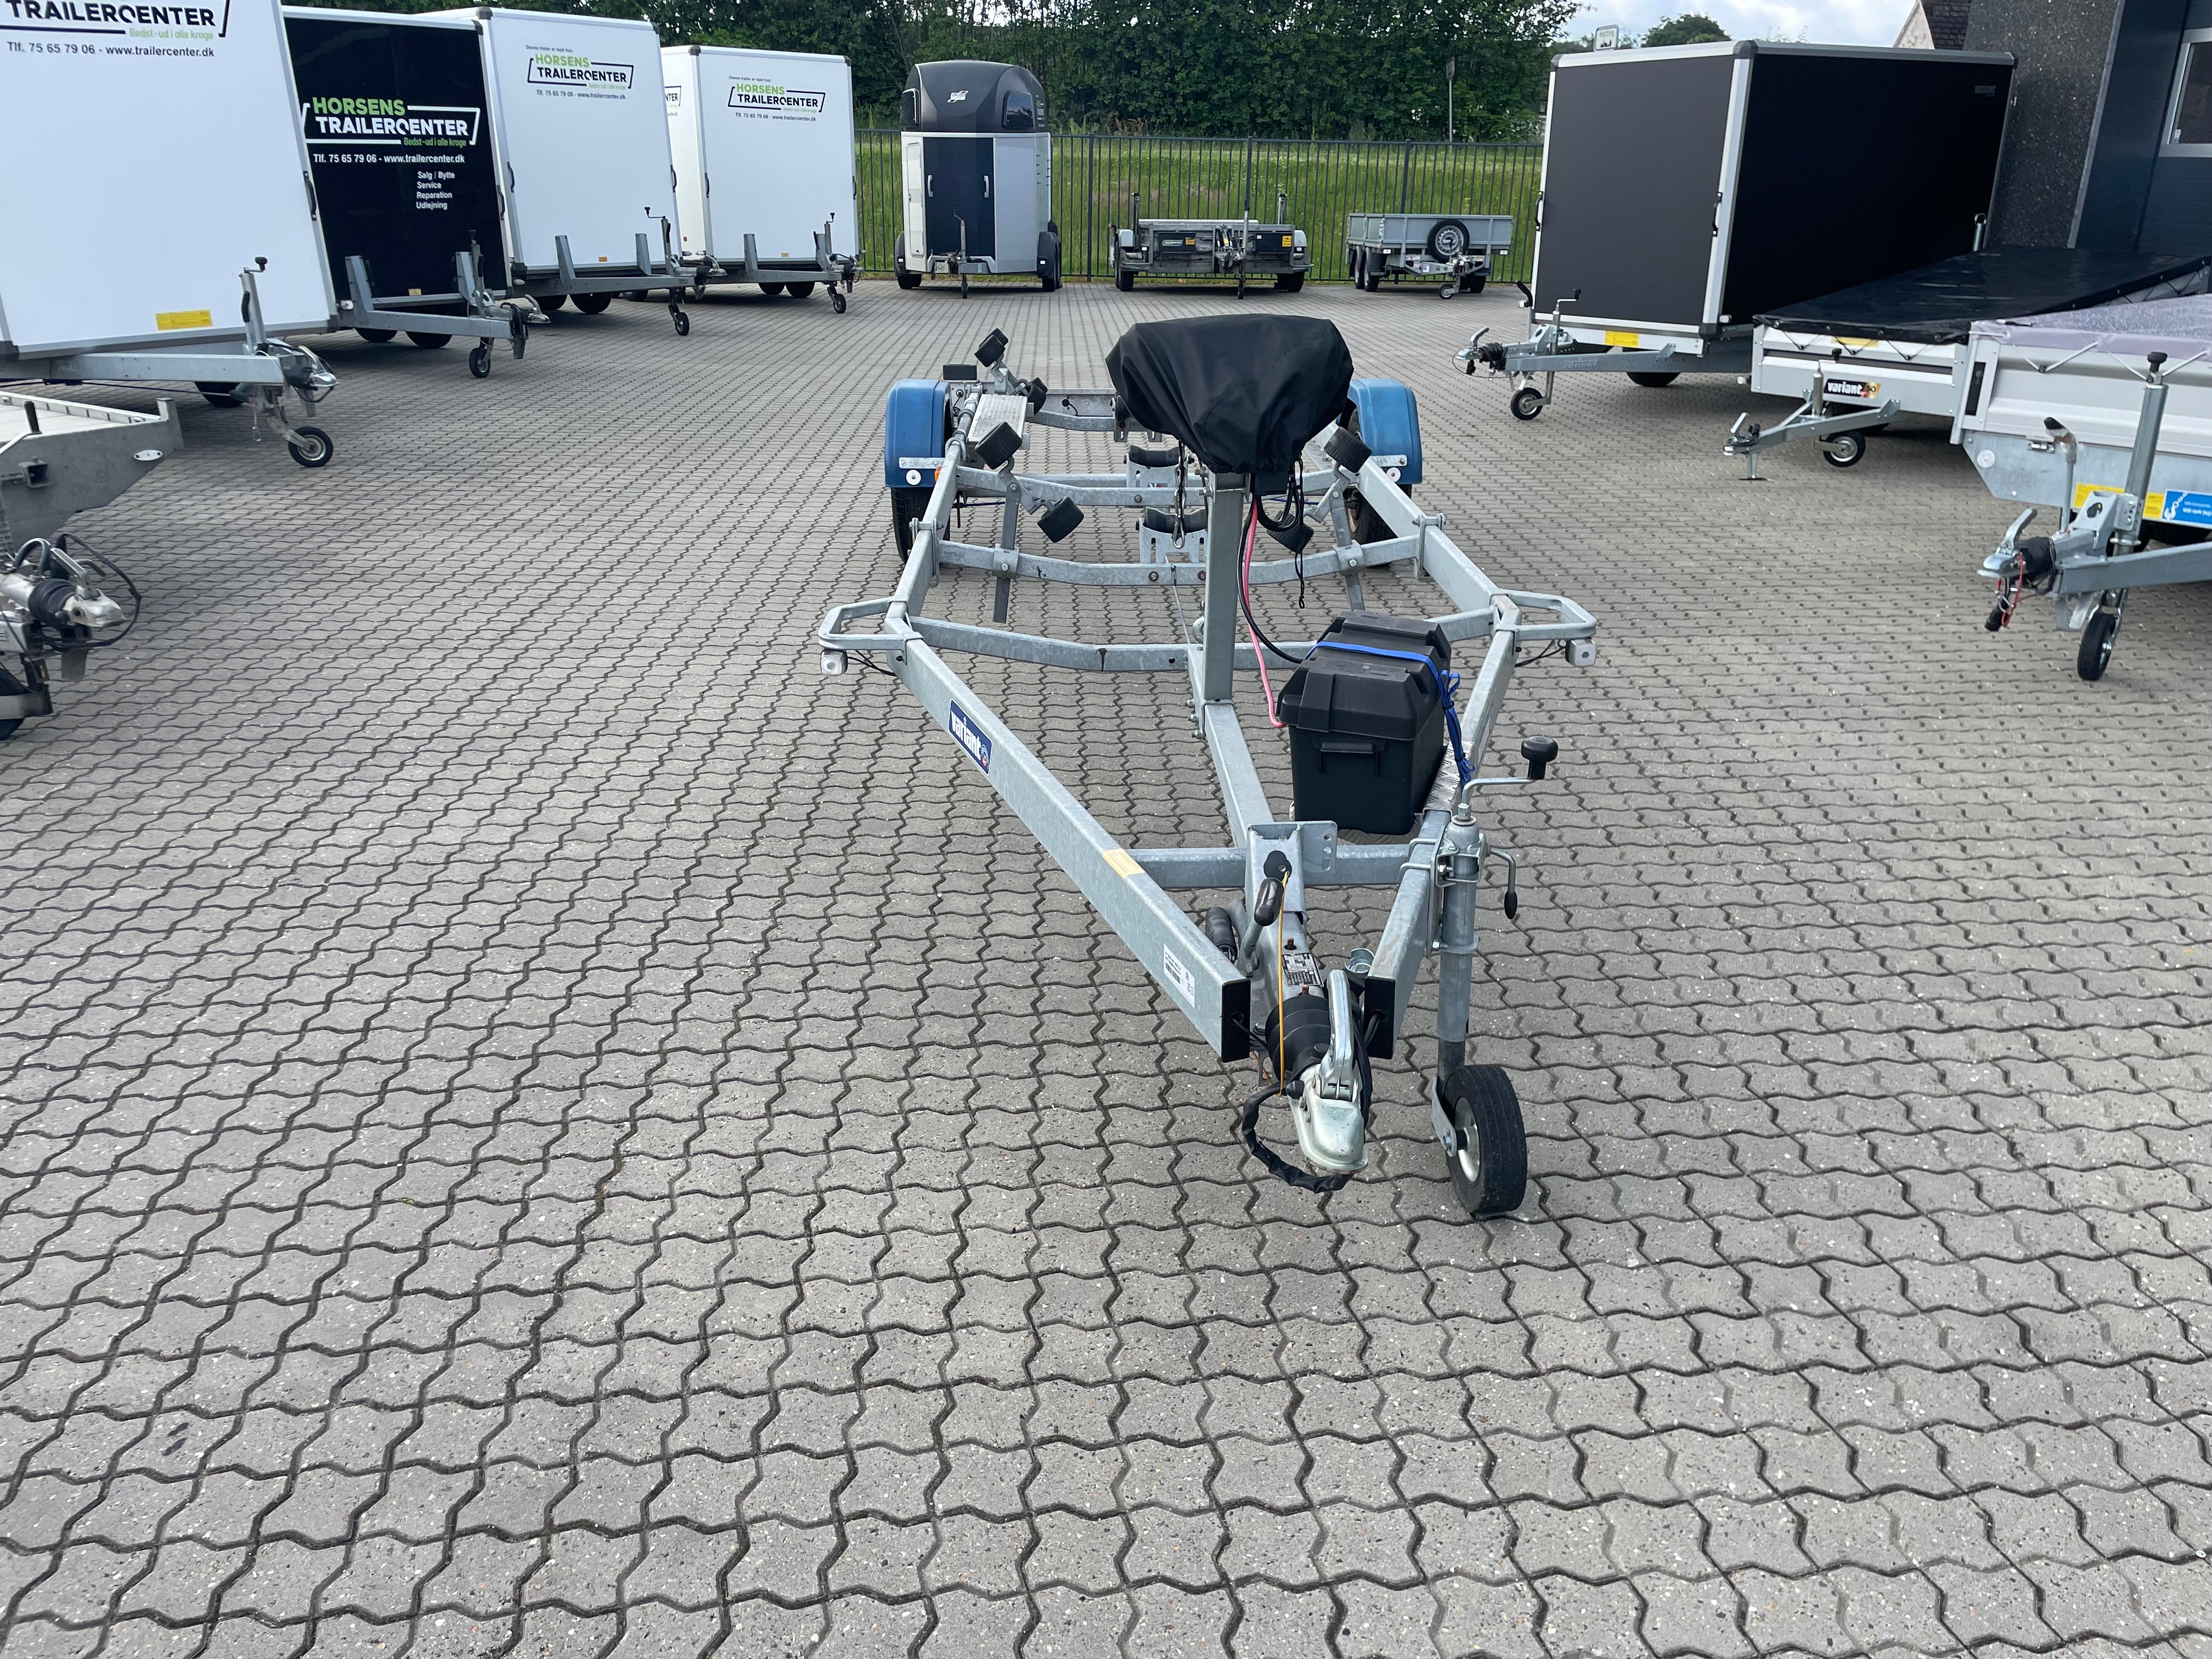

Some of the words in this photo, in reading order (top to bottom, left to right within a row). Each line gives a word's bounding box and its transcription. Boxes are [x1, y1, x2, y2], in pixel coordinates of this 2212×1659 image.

[4, 0, 216, 26] TRAILERCENTER
[175, 30, 189, 39] alle
[190, 31, 213, 41] kroge
[7, 41, 25, 52] Tlf.
[29, 42, 43, 53] 75
[47, 43, 60, 53] 65
[64, 44, 77, 54] 79
[82, 44, 95, 54] 06
[105, 46, 215, 57] www.trailercenter.dk
[535, 53, 590, 67] HORSENS
[537, 66, 627, 83] TRAILERCENTER
[737, 83, 785, 95] HORSENS
[312, 97, 405, 116] HORSENS
[737, 94, 819, 108] TRAILERCENTER
[315, 116, 469, 136] TRAILERCENTER
[449, 138, 467, 148] kroge
[313, 154, 326, 162] Tlf.
[329, 154, 338, 162] 75
[341, 154, 351, 163] 65
[354, 154, 364, 163] 79
[366, 154, 376, 163] 06
[383, 154, 465, 163] www.trailercenter.dk
[417, 171, 432, 180] Salg
[438, 172, 455, 180] Bytte
[416, 191, 453, 200] Reparation
[416, 201, 448, 210] Udlejning
[1827, 381, 1863, 394] variant
[951, 710, 981, 761] variant
